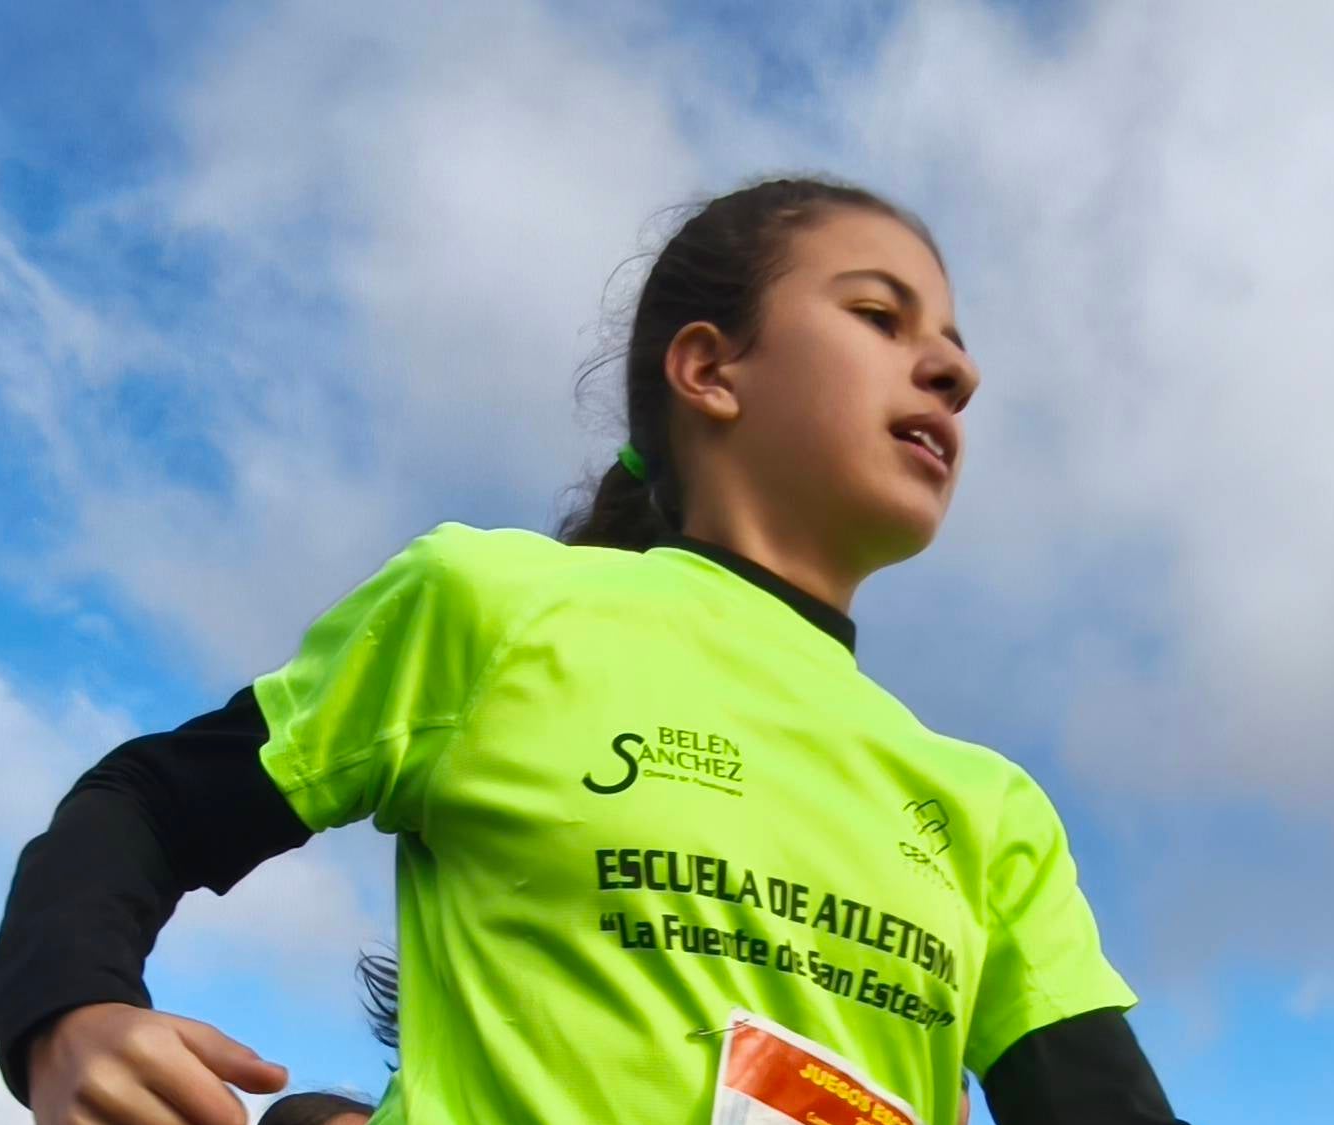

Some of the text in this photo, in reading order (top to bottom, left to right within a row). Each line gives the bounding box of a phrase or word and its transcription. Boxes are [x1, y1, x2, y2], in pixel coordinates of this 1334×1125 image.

[595, 848, 958, 992] ESCUELA DE ATLETISM
[662, 914, 769, 967] Fuente
[775, 939, 808, 977] de
[807, 949, 854, 998] San
